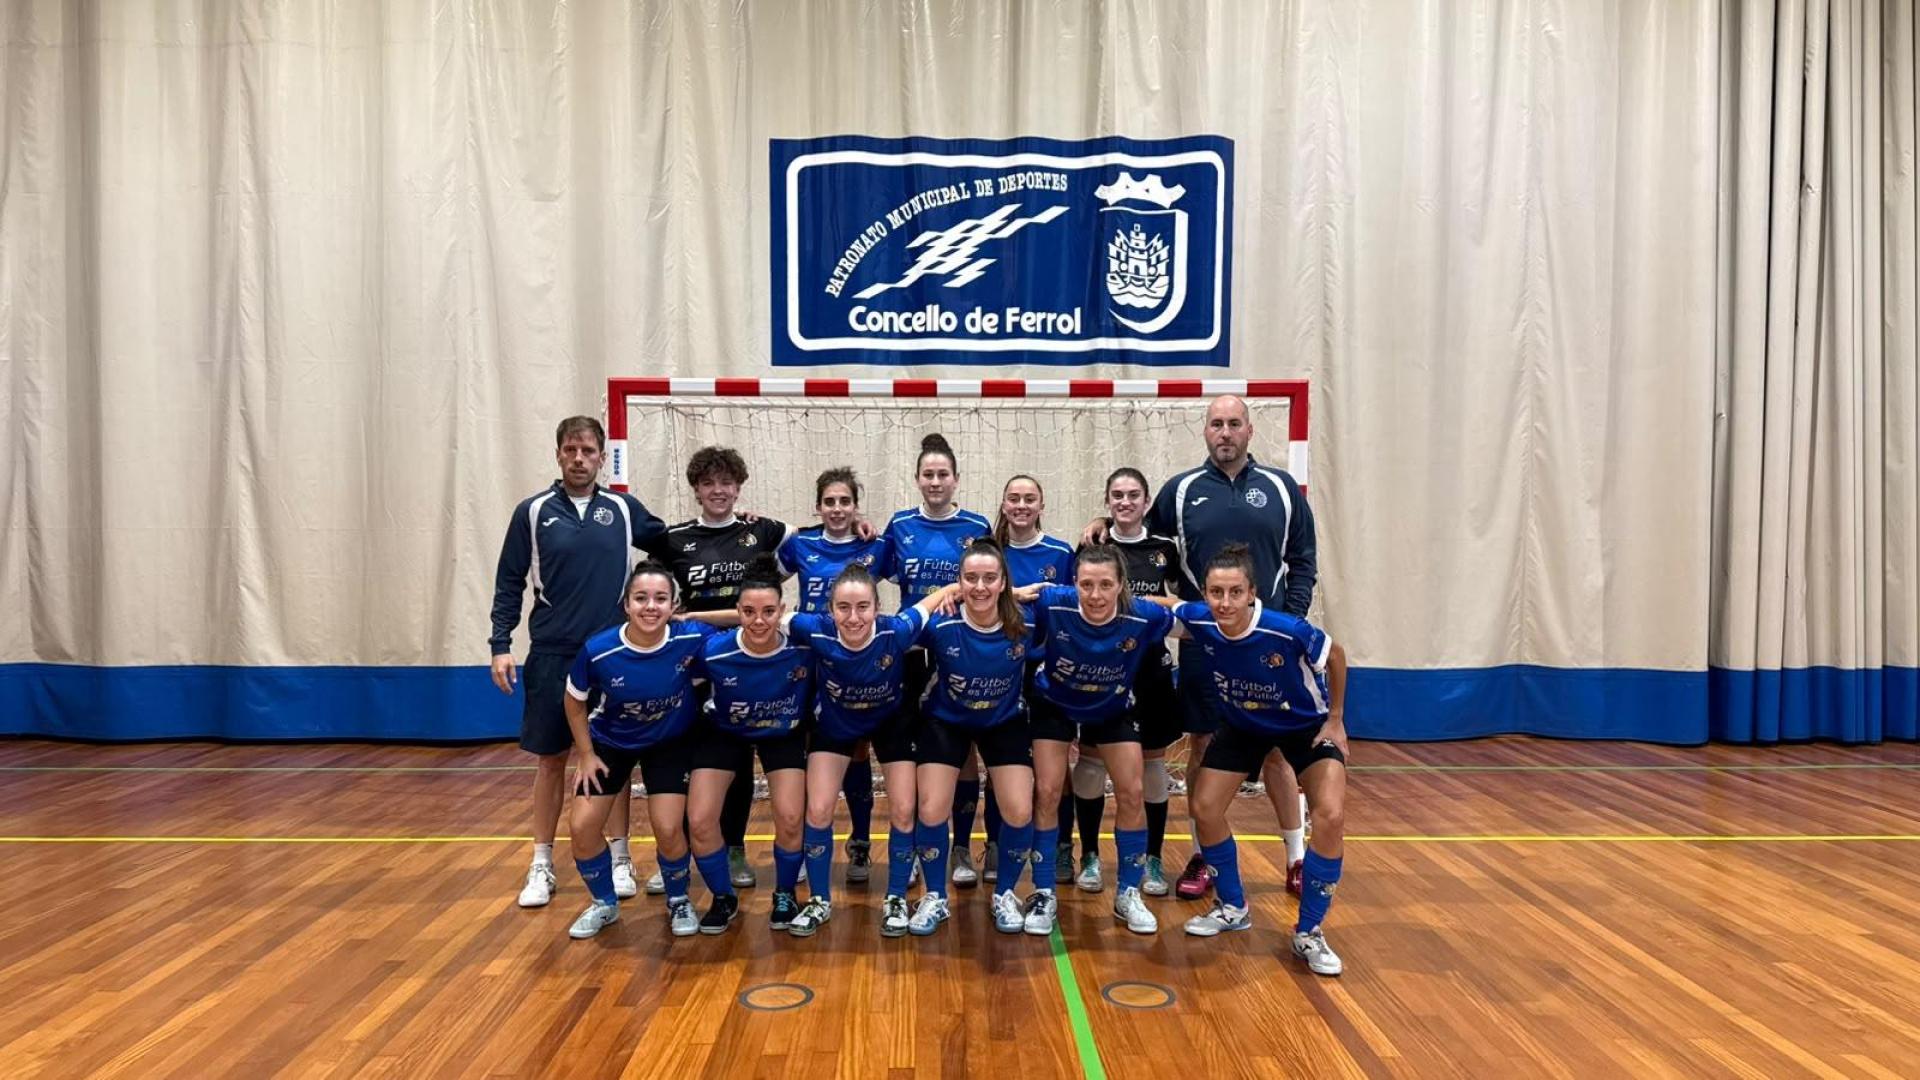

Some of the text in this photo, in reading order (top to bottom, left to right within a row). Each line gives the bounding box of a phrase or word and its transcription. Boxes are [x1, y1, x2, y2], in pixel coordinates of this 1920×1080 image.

[825, 171, 1067, 298] PATRONATO MUNICIPAL DE DEPORTES
[849, 304, 1081, 334] Concello de Ferrol
[924, 558, 960, 572] Fútbo
[1128, 580, 1160, 593] útbol
